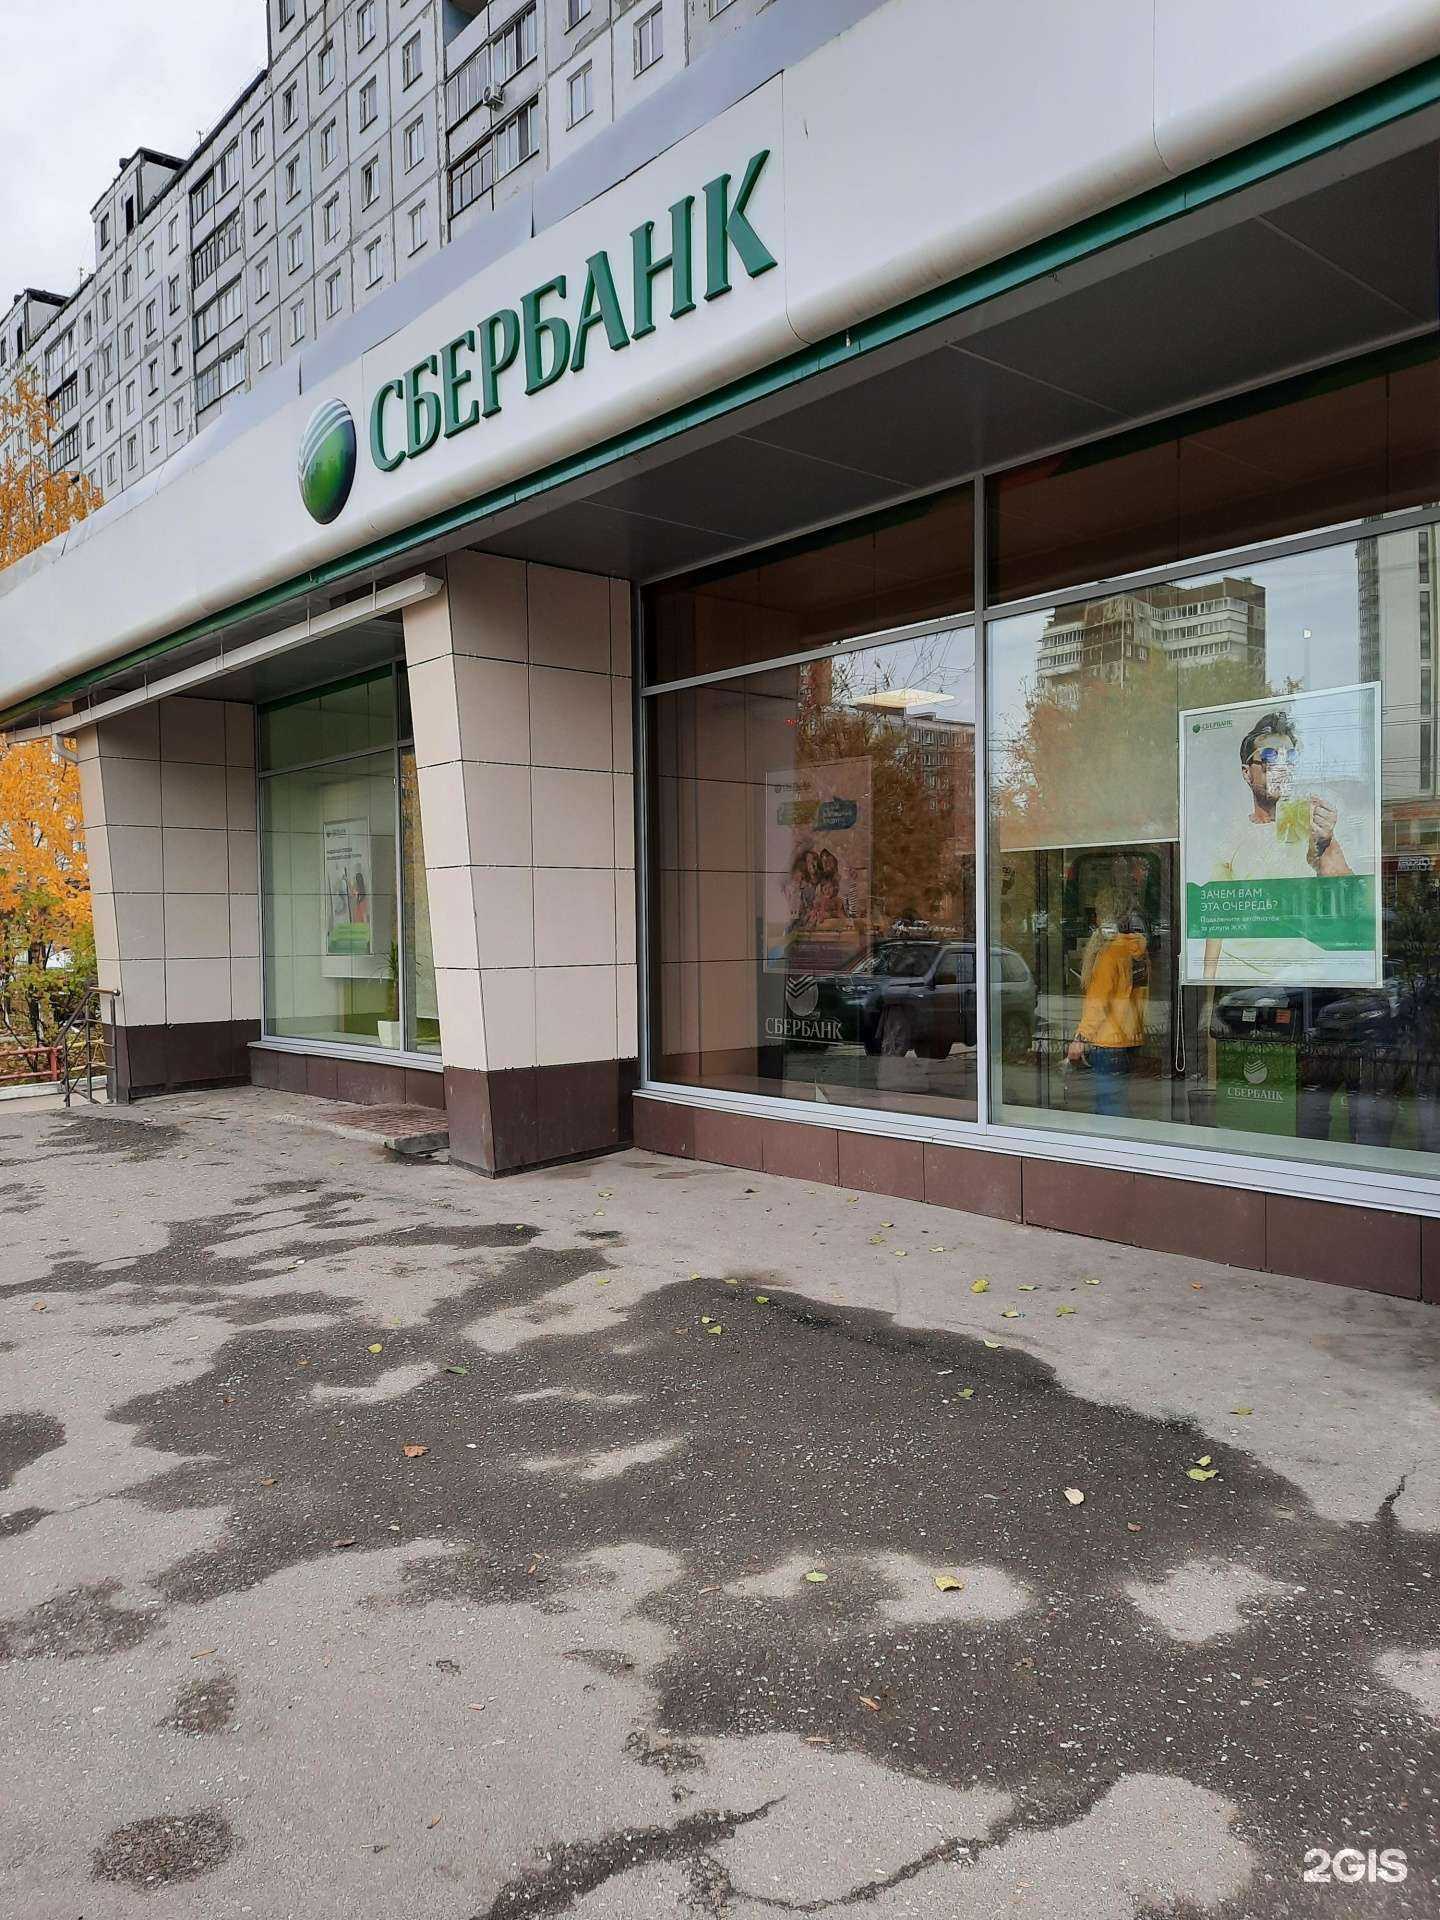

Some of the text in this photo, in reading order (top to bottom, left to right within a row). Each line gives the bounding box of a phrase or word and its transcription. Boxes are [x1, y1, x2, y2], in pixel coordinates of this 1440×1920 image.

[369, 149, 778, 473] СБЕРБАНК
[1200, 888, 1262, 900] ЗАЧЕМ ВАМ
[1200, 900, 1278, 912] ЭТА ОЧЕРЕДЬ?
[765, 1017, 843, 1040] СБЕРБАНК
[1227, 1087, 1285, 1101] СБЕРБАНК
